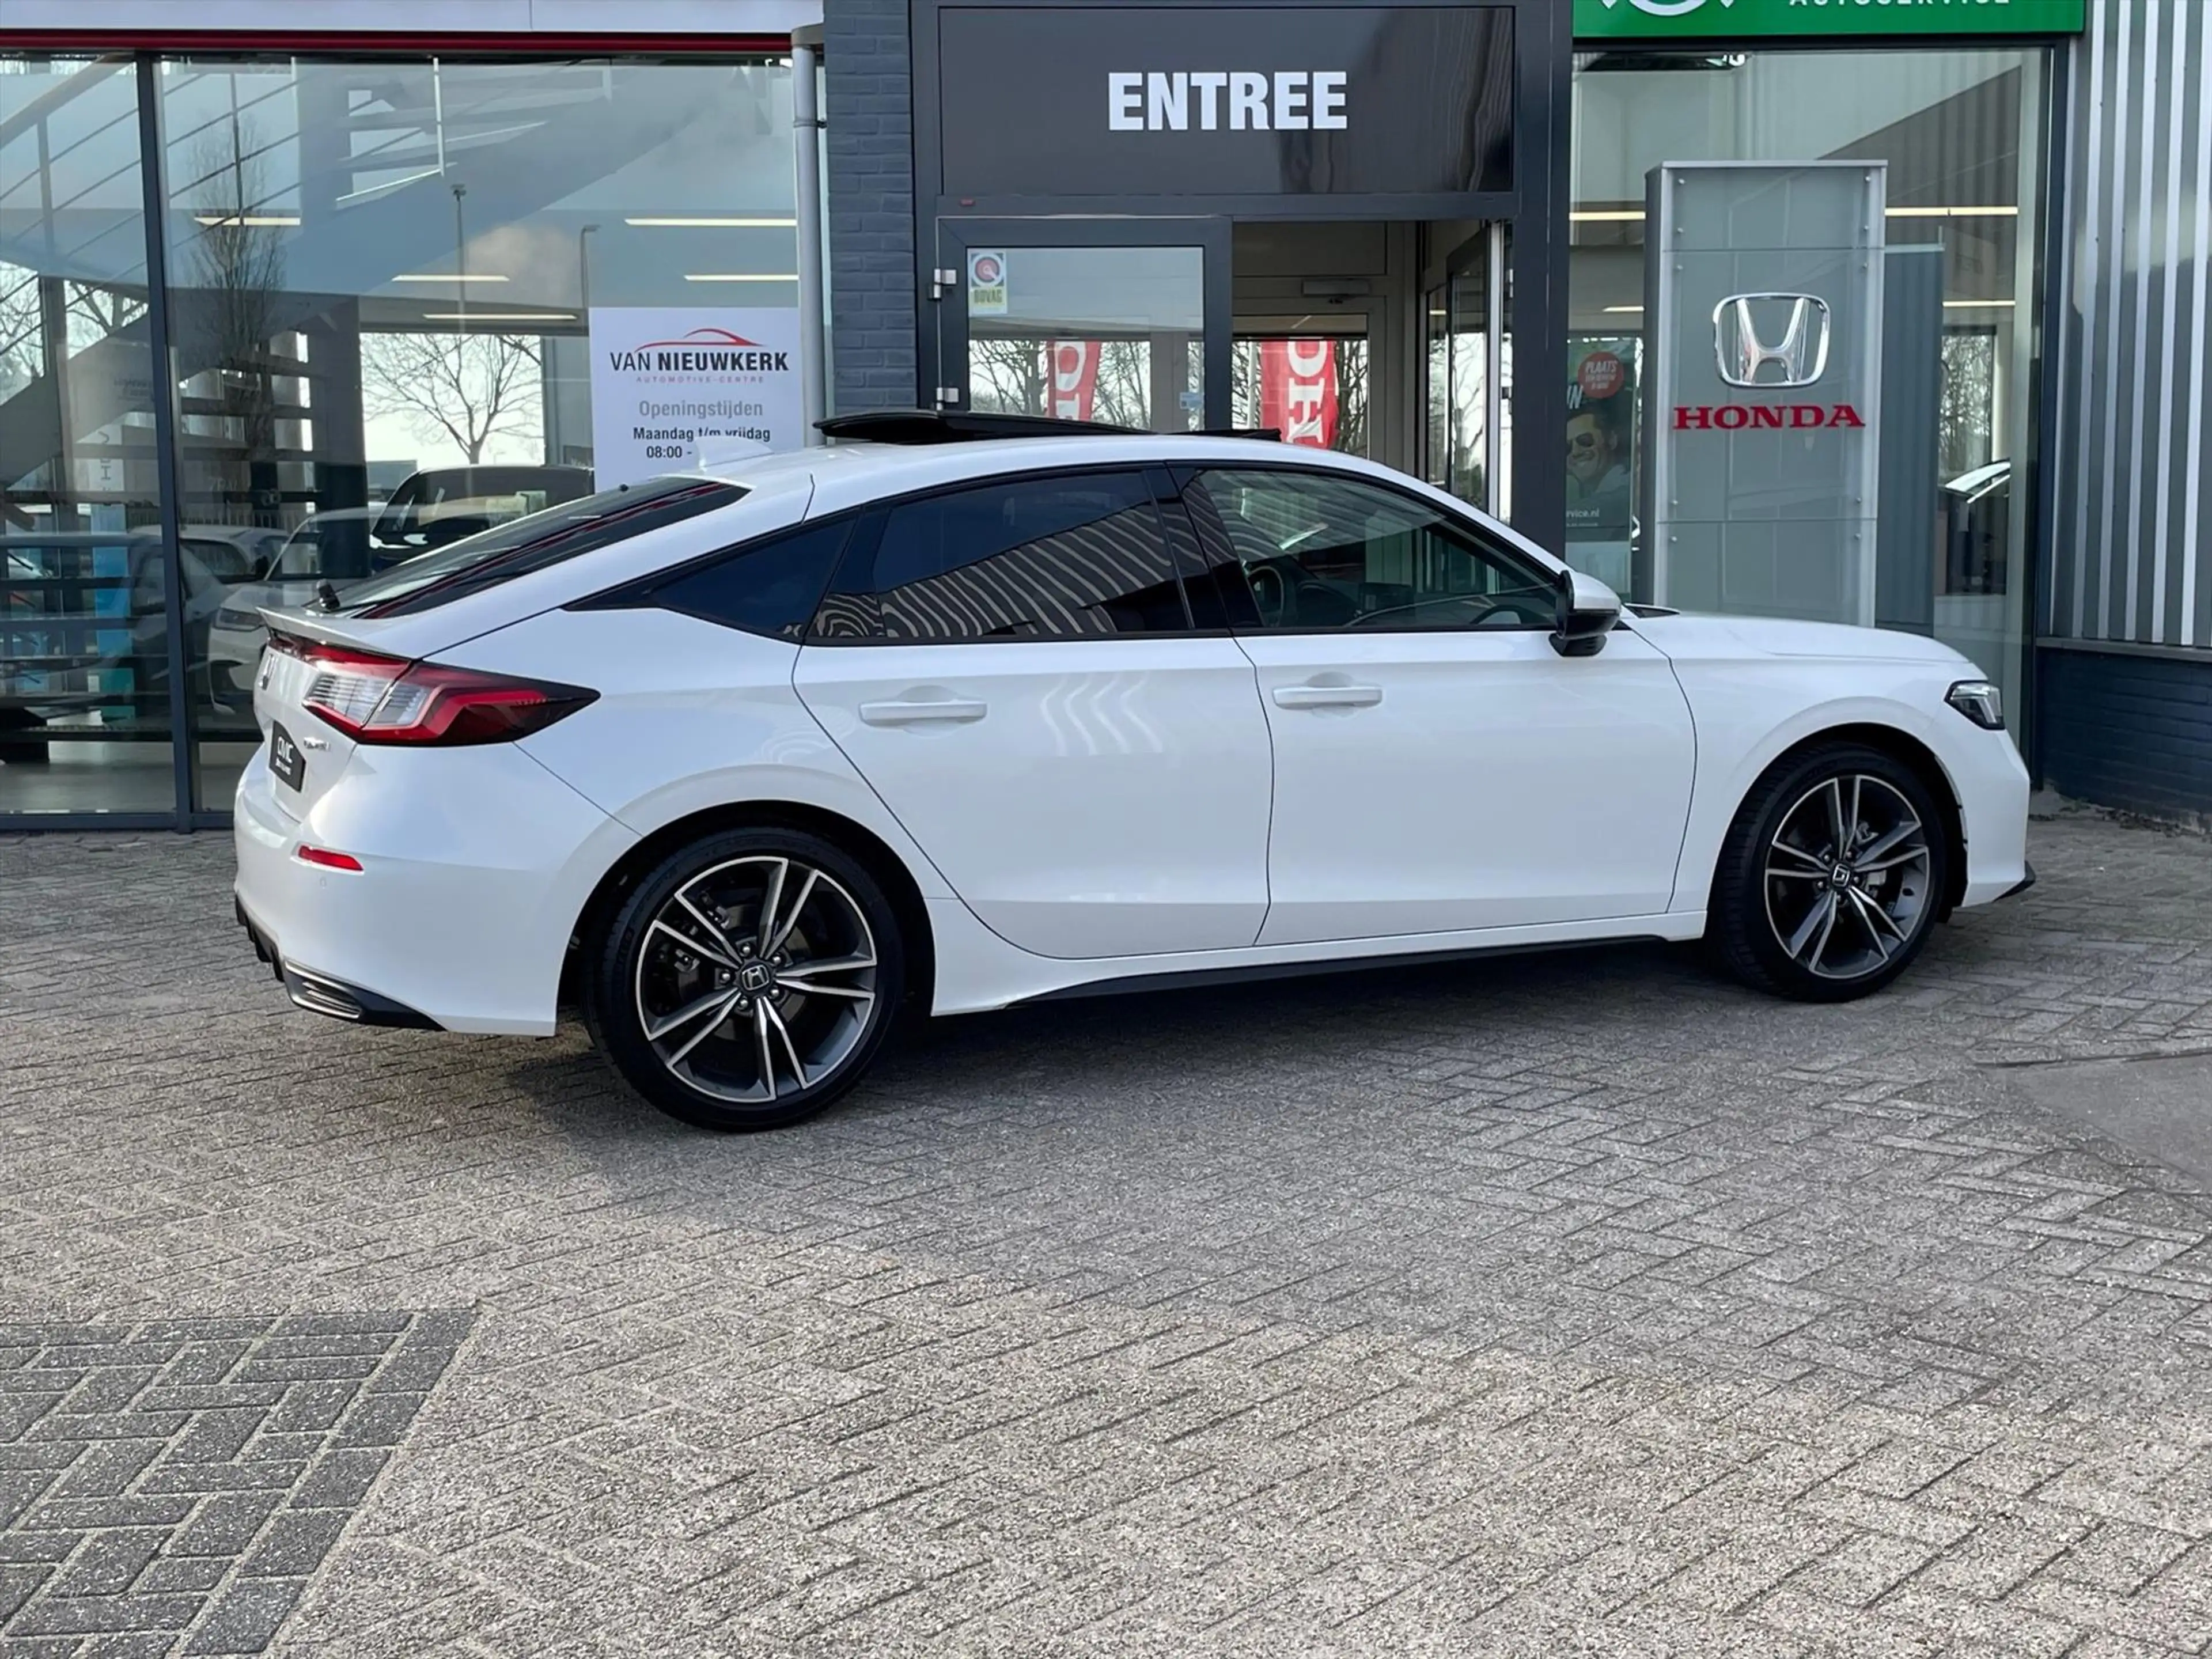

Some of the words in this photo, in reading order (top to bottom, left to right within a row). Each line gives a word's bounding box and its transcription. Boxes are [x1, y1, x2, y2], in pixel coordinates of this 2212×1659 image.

[1108, 71, 1347, 131] ENTREE
[609, 352, 650, 371] VAN
[658, 352, 789, 371] NIEUWKERK
[639, 400, 763, 419] Openingstijden
[1673, 404, 1866, 430] HONDA
[633, 427, 694, 442] Maandag
[646, 446, 683, 459] 08:00
